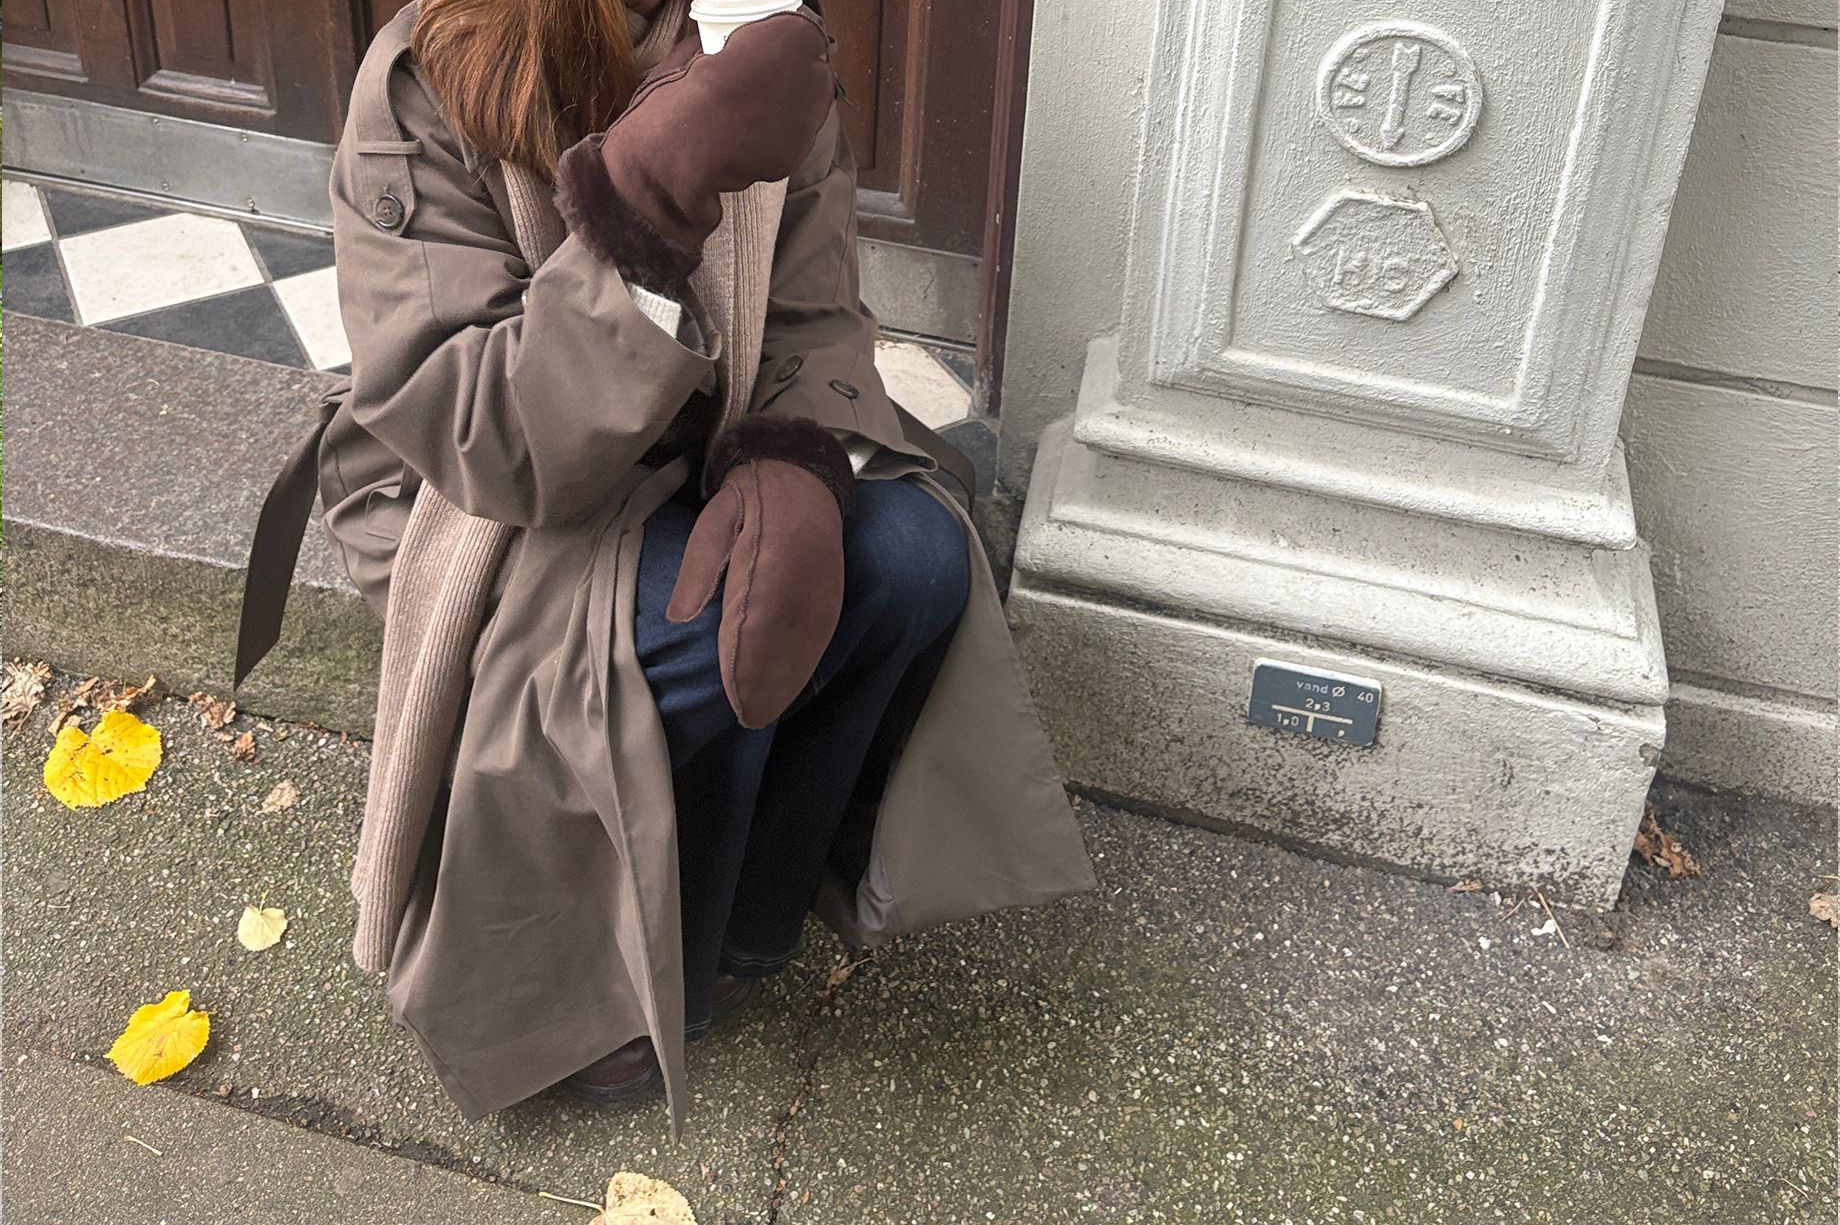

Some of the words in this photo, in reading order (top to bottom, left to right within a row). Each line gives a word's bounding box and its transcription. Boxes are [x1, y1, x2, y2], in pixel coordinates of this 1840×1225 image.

[1296, 681, 1329, 694] vand
[1357, 691, 1374, 703] 40
[1305, 698, 1331, 712] 2,3
[1276, 713, 1299, 727] 1,0
